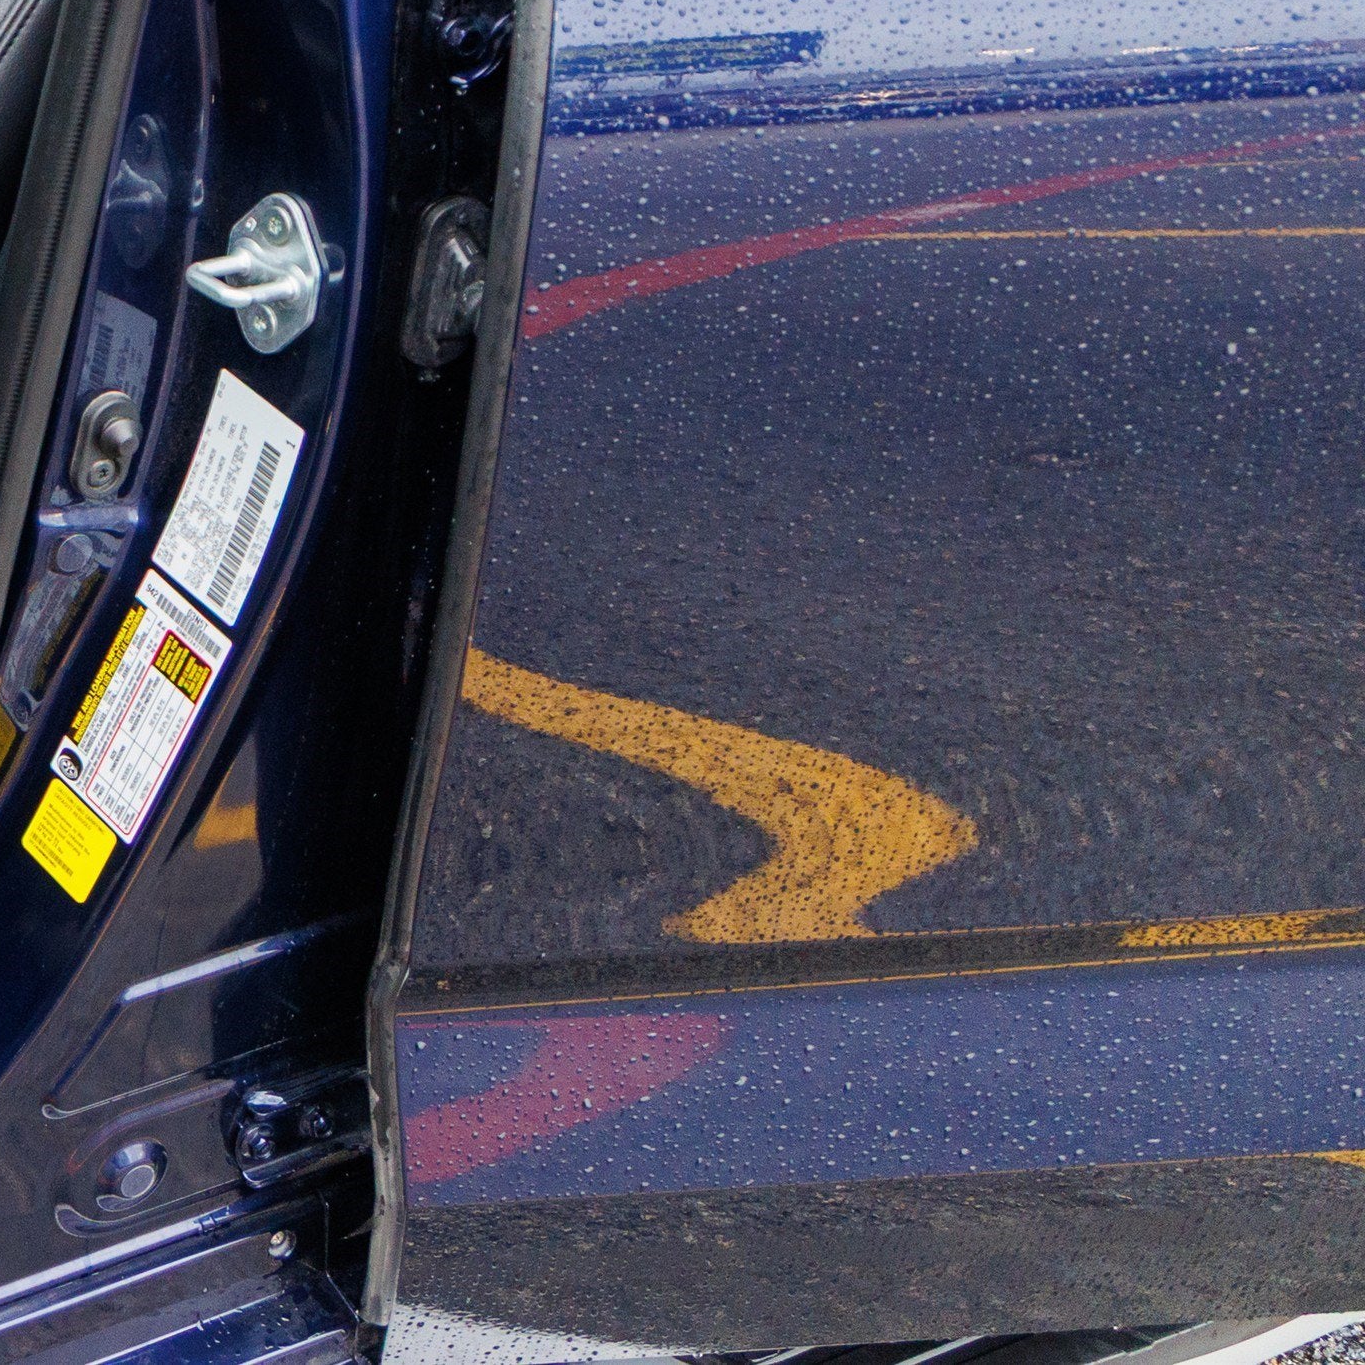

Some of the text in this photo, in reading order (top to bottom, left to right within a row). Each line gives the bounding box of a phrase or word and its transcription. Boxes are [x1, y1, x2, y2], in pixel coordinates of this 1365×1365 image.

[145, 583, 158, 599] 942
[72, 608, 136, 730] TIRE AND LOADING INFORMATION
